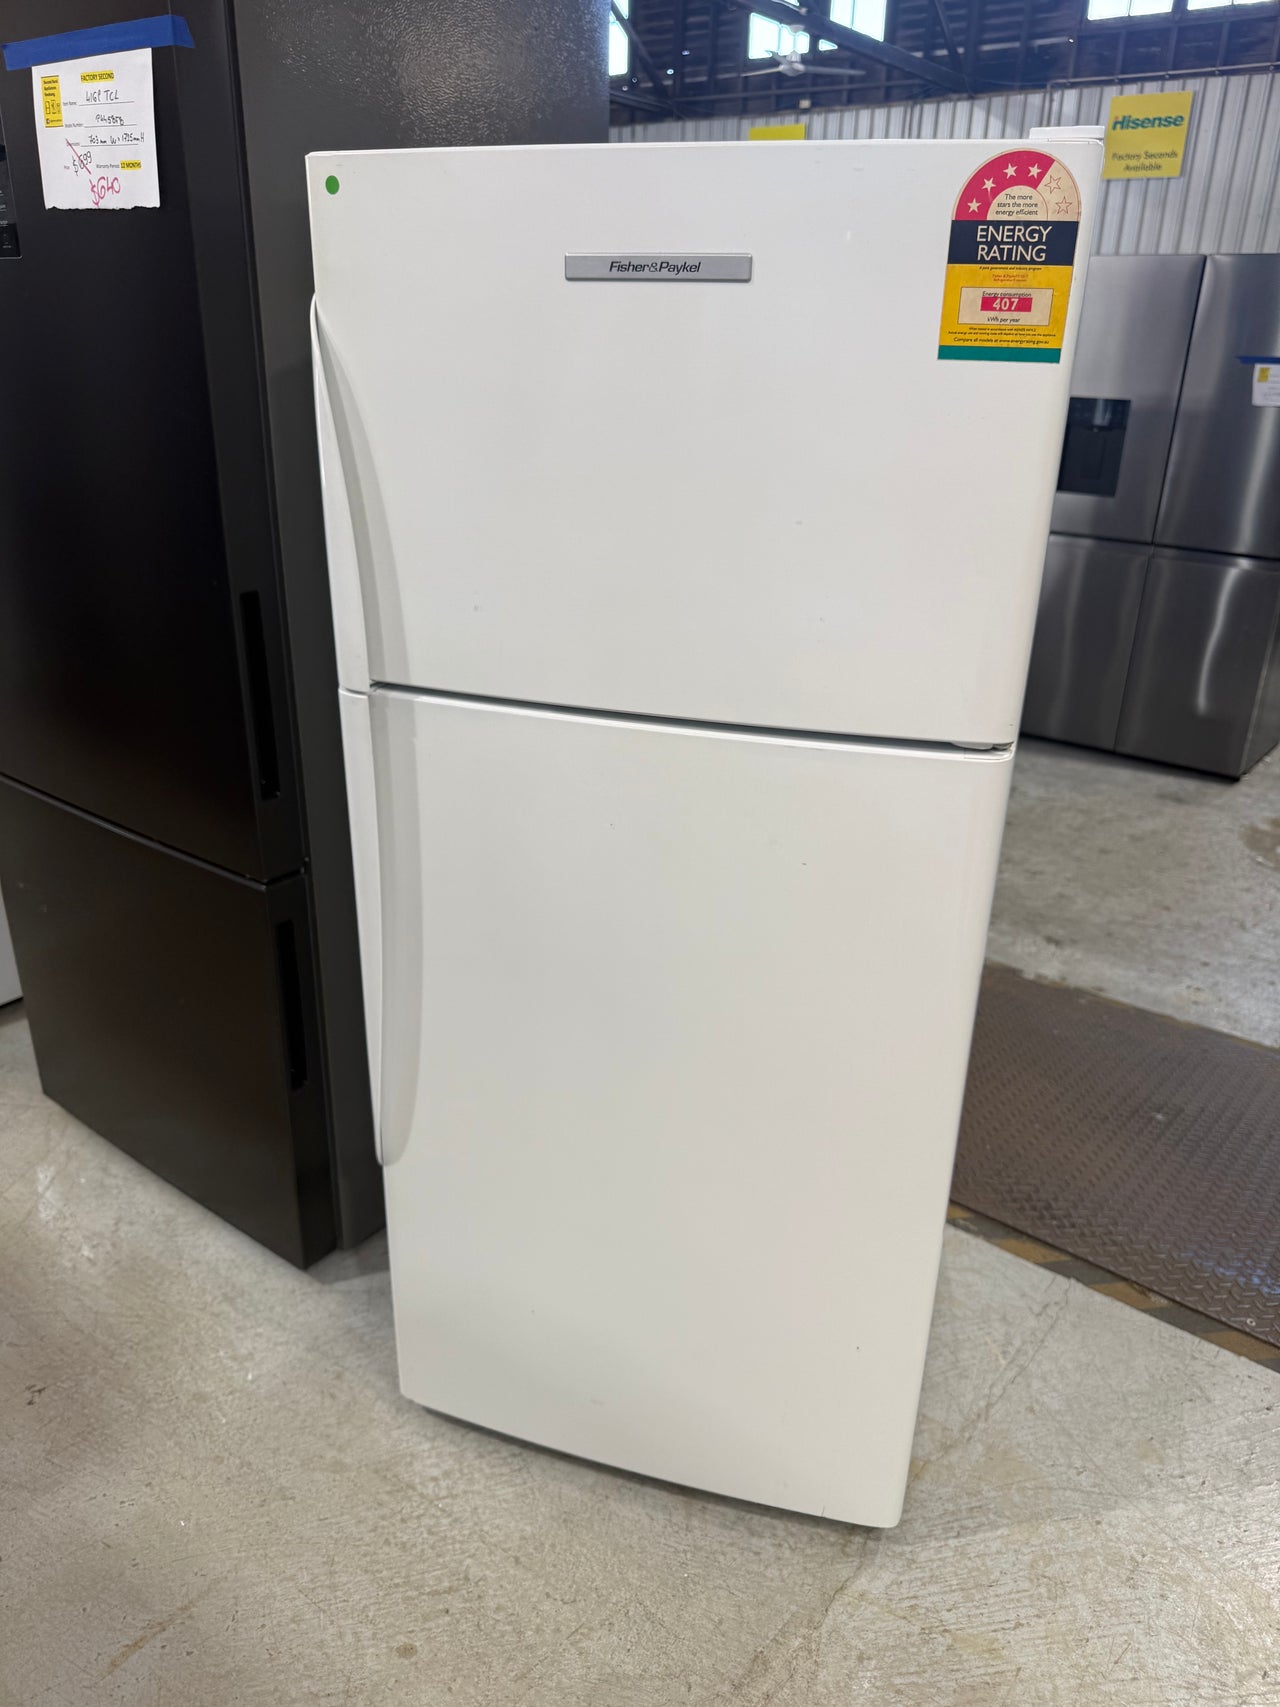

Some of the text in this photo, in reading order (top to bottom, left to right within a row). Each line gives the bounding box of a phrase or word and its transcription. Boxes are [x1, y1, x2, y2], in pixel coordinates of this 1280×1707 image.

[98, 72, 114, 80] SECOND
[104, 90, 119, 101] TCL
[1112, 115, 1184, 131] Hisense
[89, 176, 121, 207] $640
[976, 226, 1052, 242] ENERGY
[977, 245, 1046, 261] RATING
[609, 261, 701, 275] Fisher&Paykel
[993, 299, 1019, 311] 407
